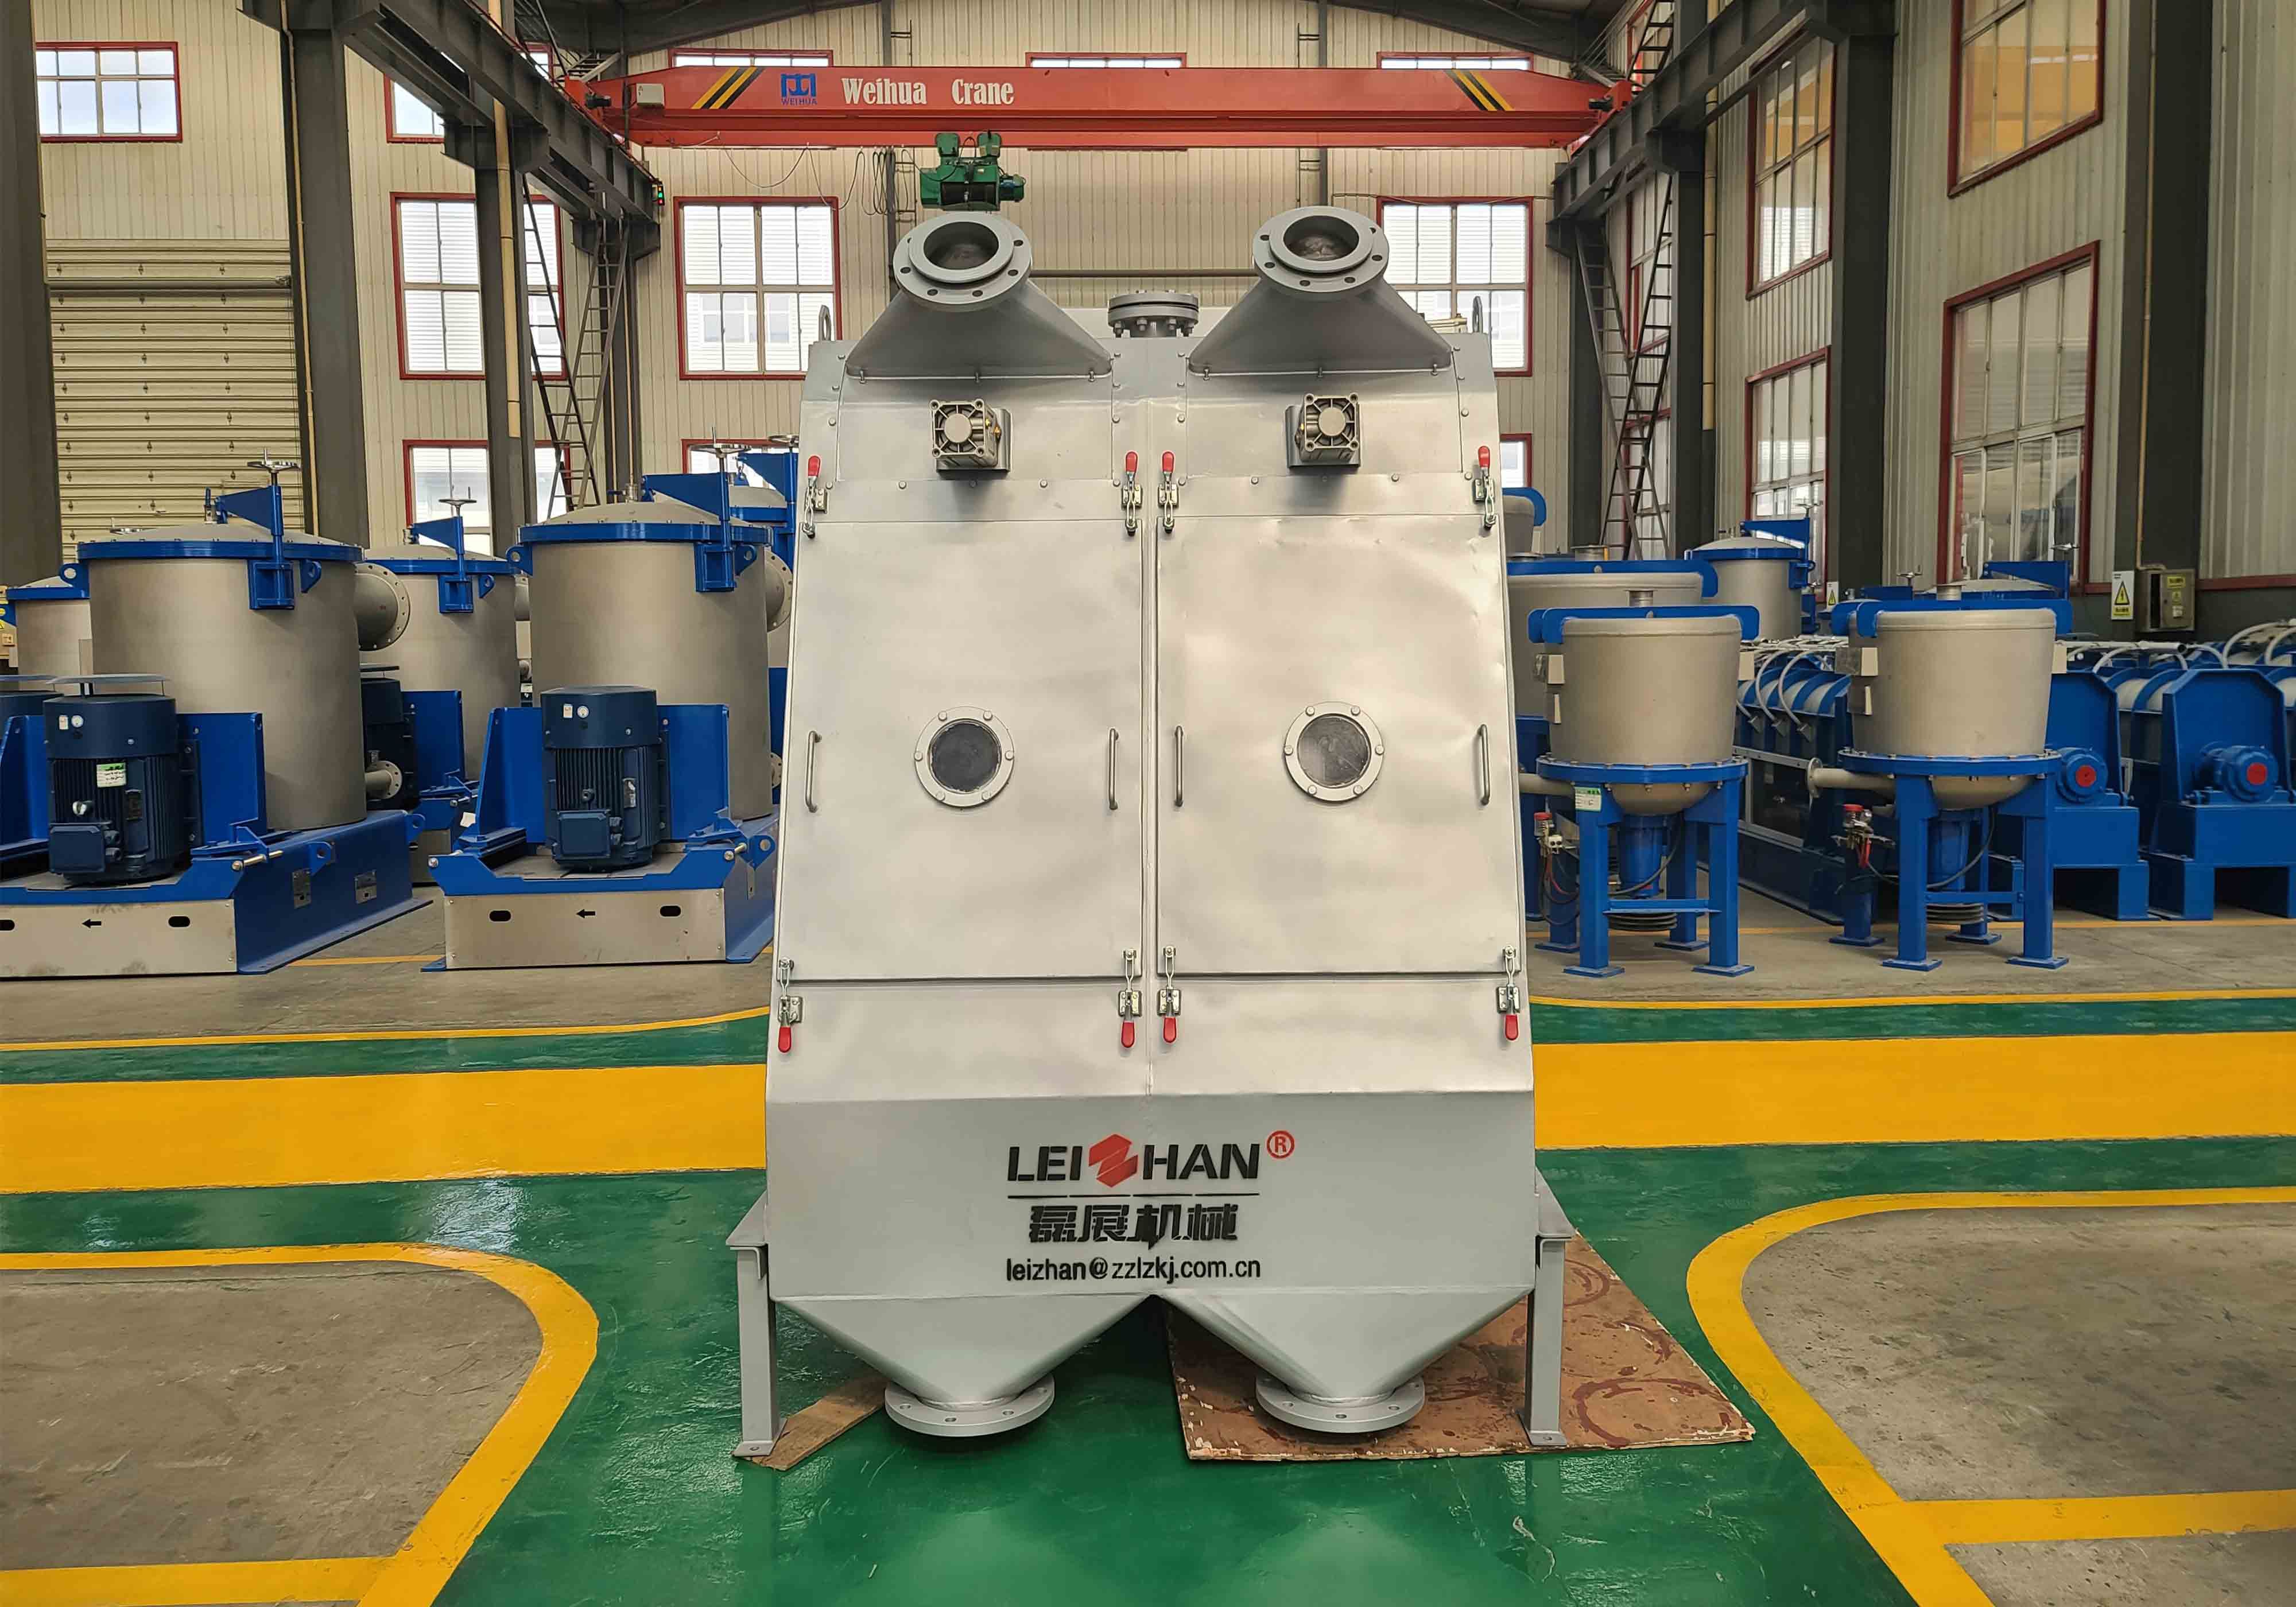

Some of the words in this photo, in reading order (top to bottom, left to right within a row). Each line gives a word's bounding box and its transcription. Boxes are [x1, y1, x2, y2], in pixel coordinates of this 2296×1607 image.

[841, 77, 927, 105] Weihua
[951, 79, 1014, 105] Crane
[1006, 1256, 1261, 1284] leizhan@zzlzkj.com.cn
